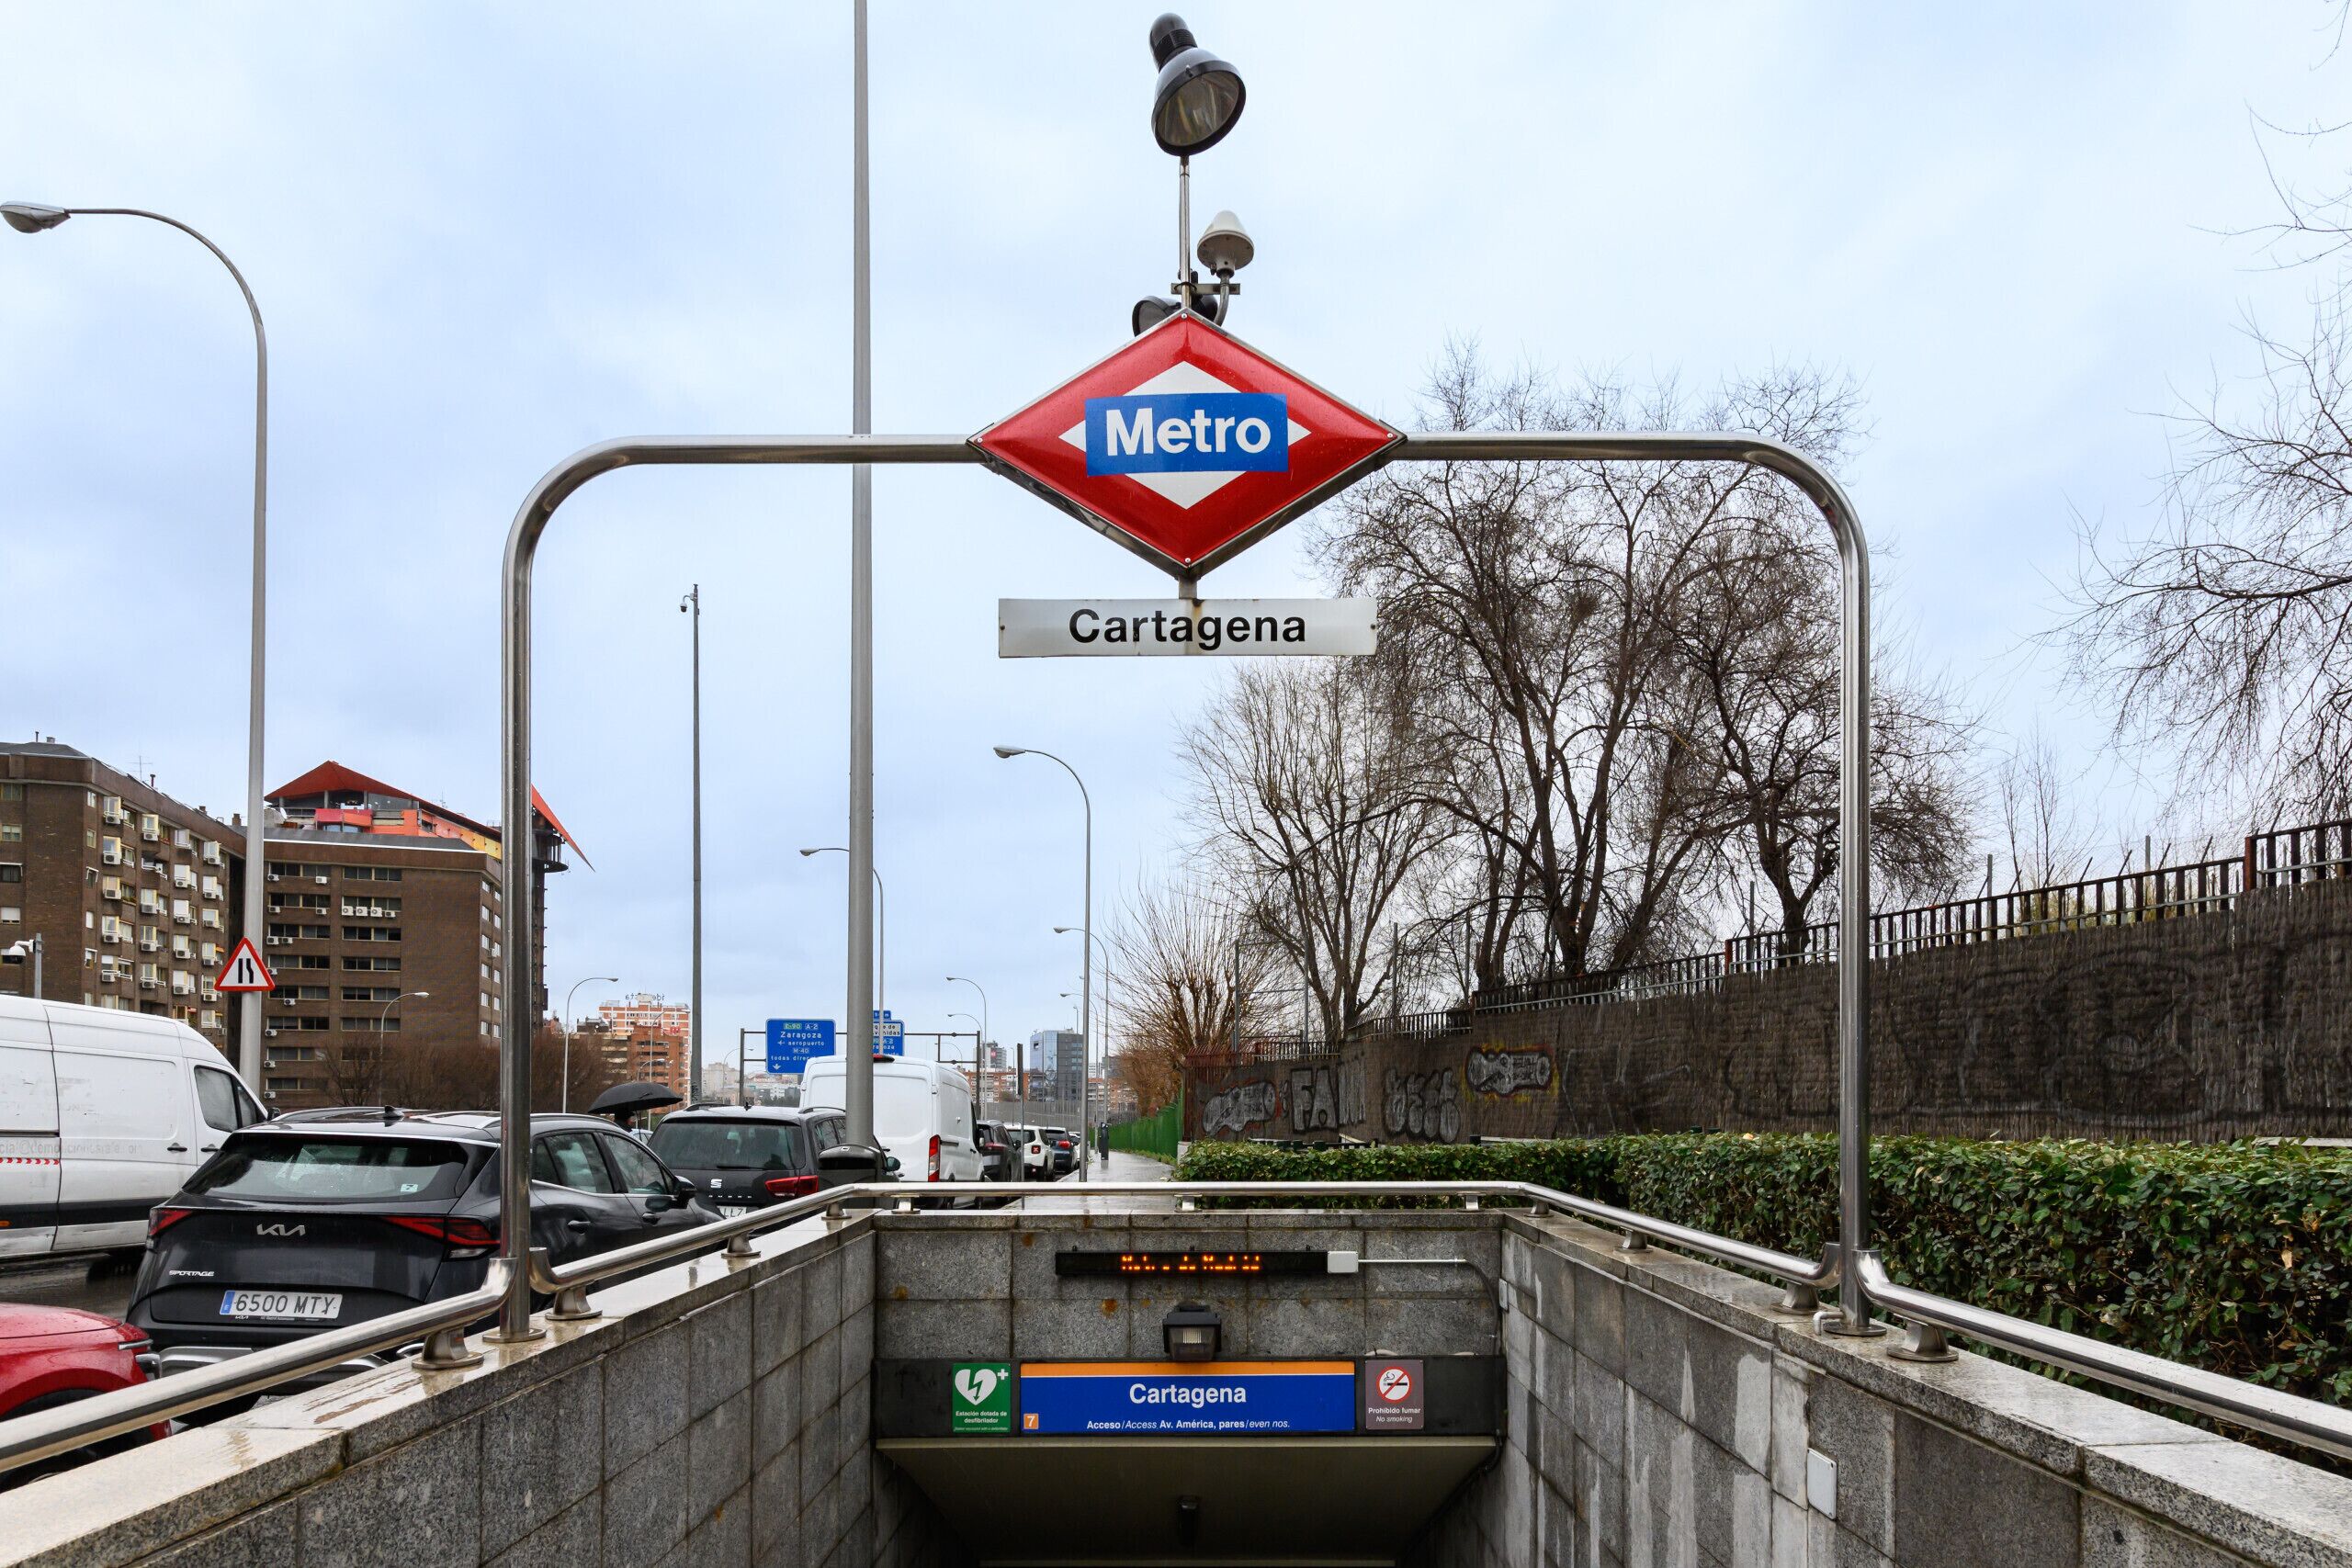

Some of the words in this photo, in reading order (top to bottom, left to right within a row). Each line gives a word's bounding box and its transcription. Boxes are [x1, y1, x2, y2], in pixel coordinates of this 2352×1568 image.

[1105, 407, 1272, 457] Metro
[1069, 608, 1306, 651] Cartagena
[780, 1031, 822, 1039] Zaragoza
[256, 1224, 306, 1236] KIA
[235, 1293, 288, 1314] 6500
[293, 1295, 335, 1315] MTY
[1129, 1382, 1247, 1409] Cartagena
[1026, 1415, 1035, 1427] 7
[1159, 1420, 1173, 1429] Av.
[1176, 1419, 1216, 1429] América,
[1272, 1420, 1291, 1428] nos.
